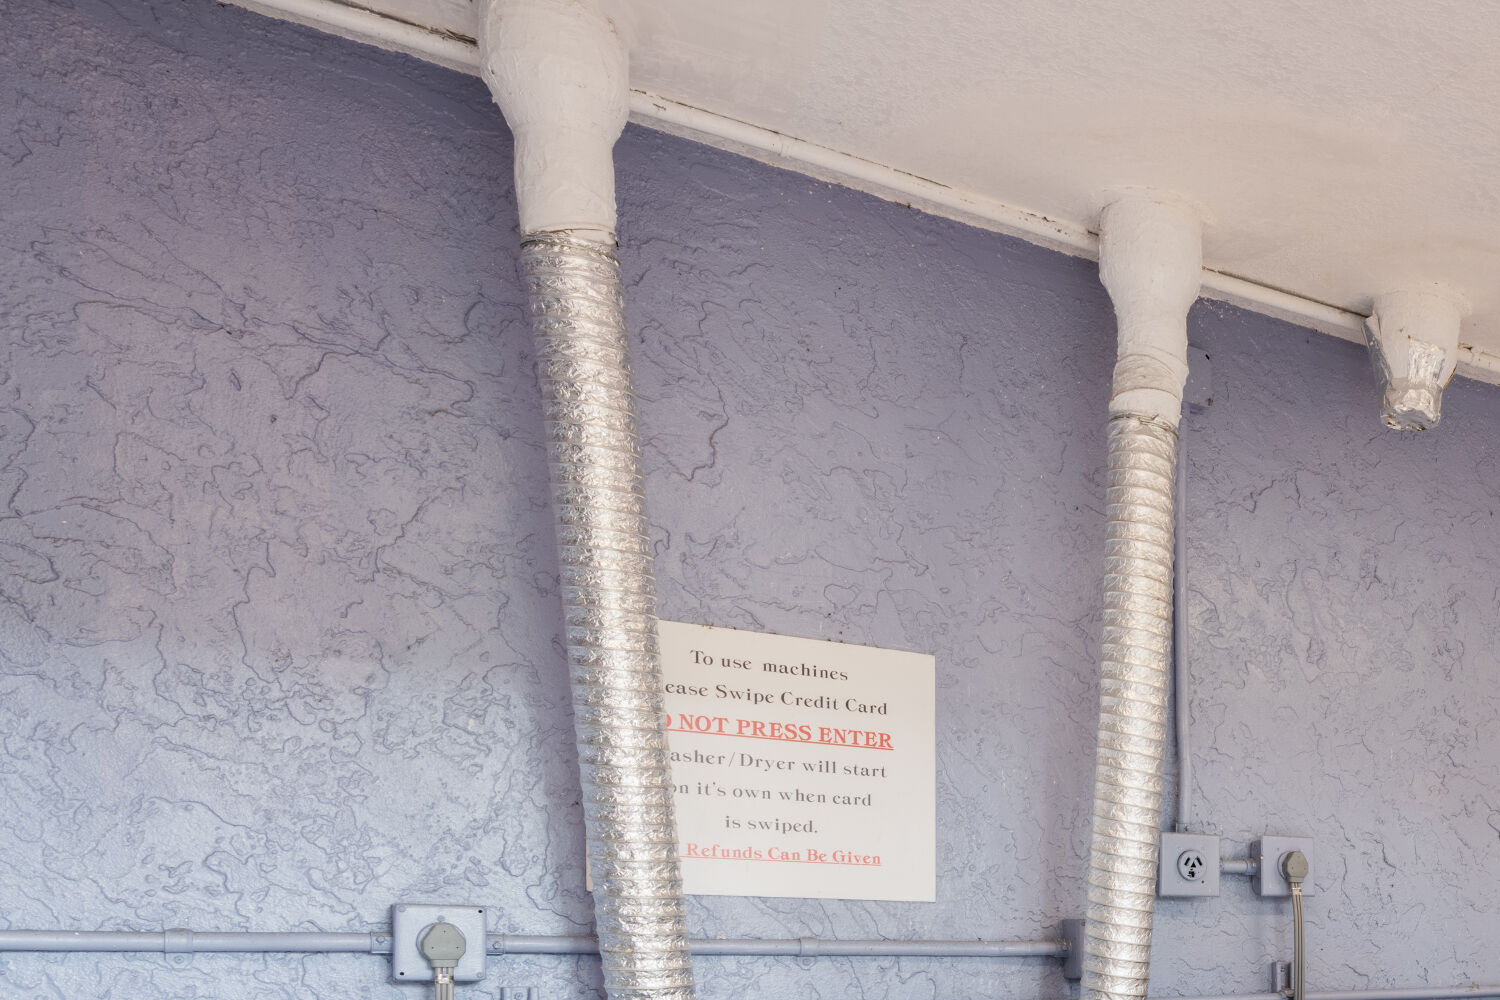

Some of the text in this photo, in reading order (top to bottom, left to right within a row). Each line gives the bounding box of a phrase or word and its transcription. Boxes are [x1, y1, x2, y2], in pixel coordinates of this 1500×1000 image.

[690, 649, 849, 681] To use machines
[665, 682, 888, 715] ease Swipe Credit Card
[679, 713, 729, 733] NOT
[736, 719, 812, 742] PRESS
[819, 726, 894, 749] ENTER
[670, 749, 887, 778] asher/Dryer will start
[696, 781, 727, 797] it's
[732, 787, 771, 800] own
[779, 788, 826, 803] when
[832, 794, 872, 806] card
[725, 815, 819, 834] is swiped.
[687, 842, 881, 865] Refunds Can Be Given
